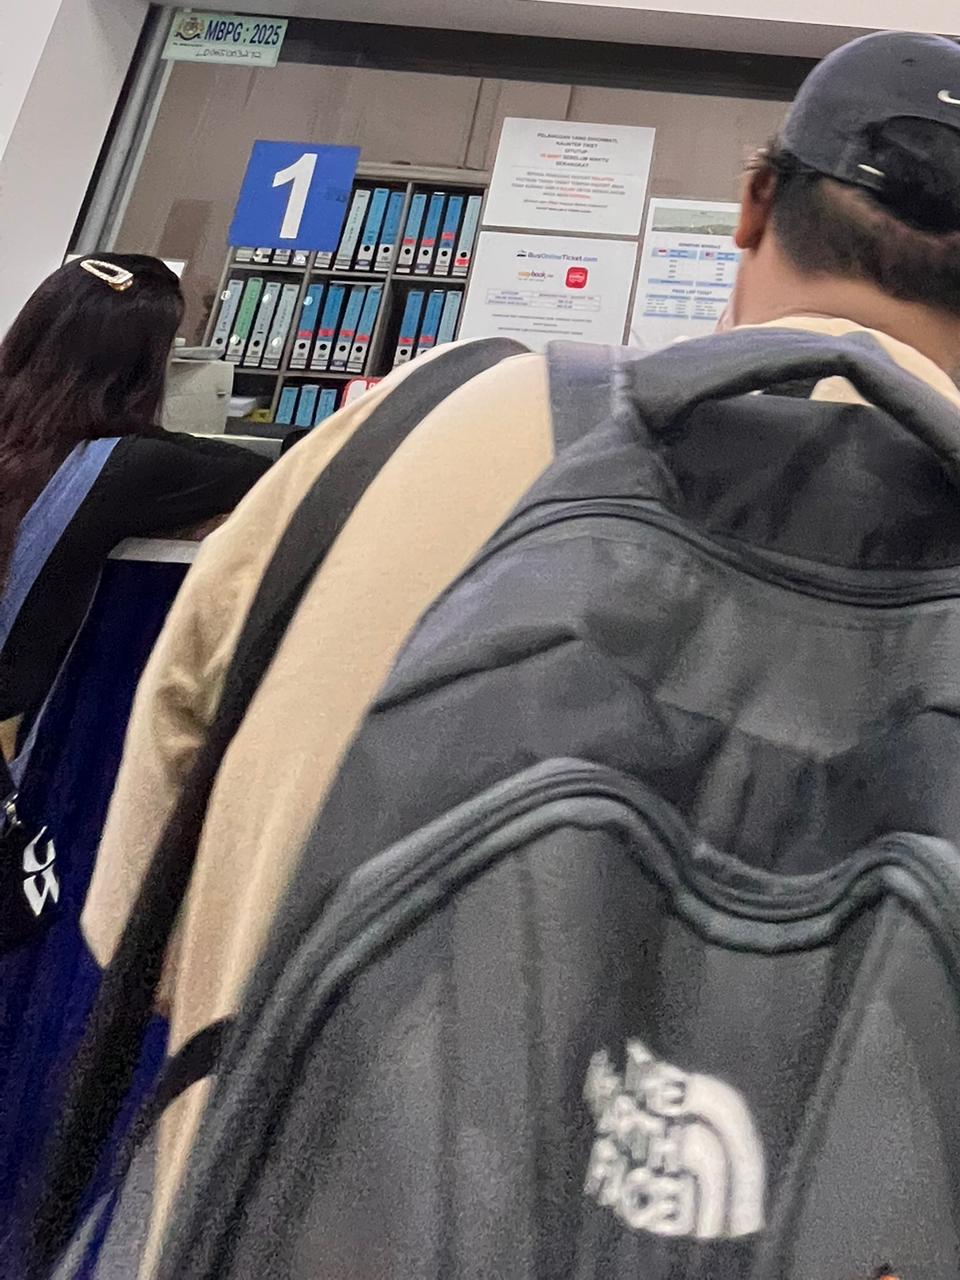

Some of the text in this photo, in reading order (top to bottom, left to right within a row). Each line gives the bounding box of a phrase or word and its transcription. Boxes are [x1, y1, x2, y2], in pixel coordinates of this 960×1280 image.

[204, 19, 243, 42] MBPG
[249, 23, 282, 45] 2025
[272, 153, 318, 239] 1
